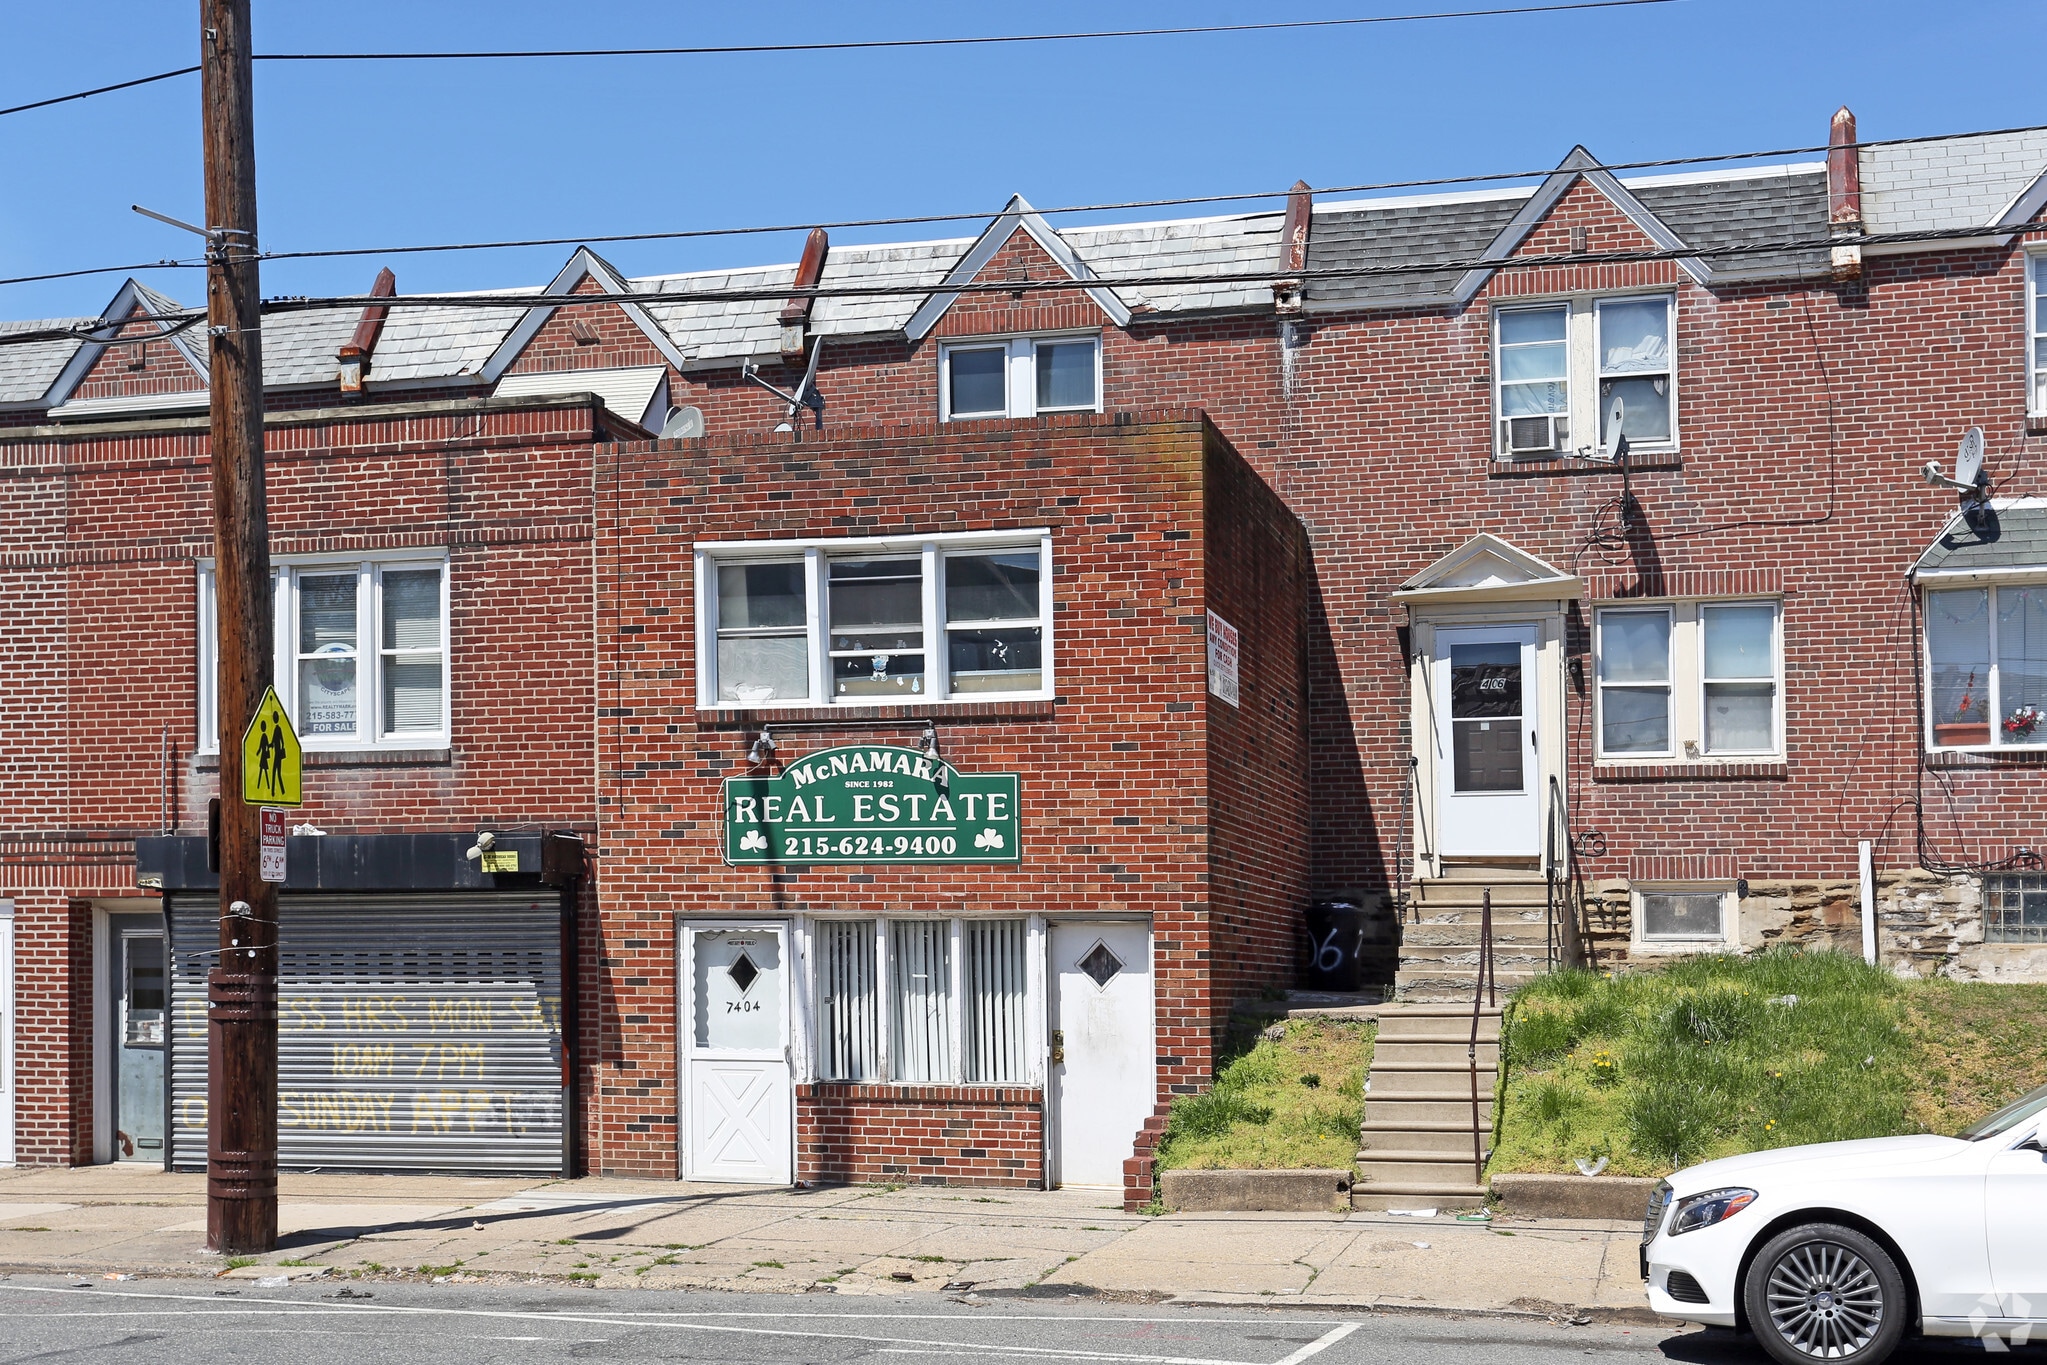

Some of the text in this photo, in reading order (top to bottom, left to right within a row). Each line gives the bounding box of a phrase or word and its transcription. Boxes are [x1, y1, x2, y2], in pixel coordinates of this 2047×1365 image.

[1209, 614, 1215, 630] WE
[1223, 624, 1236, 647] HOUSES
[1218, 638, 1236, 657] CONDITION
[1223, 653, 1232, 667] CASH
[313, 723, 356, 732] FOR SALE
[790, 751, 949, 790] McNAMARA
[844, 780, 894, 788] SINCE 1982
[734, 792, 1010, 823] REAL ESTATE
[269, 813, 277, 823] NO
[265, 823, 282, 834] TRUCK
[263, 835, 285, 846] PARKING
[784, 835, 957, 856] 215-624-9400
[726, 1000, 761, 1014] 7404
[278, 1091, 396, 1134] SUNDAY
